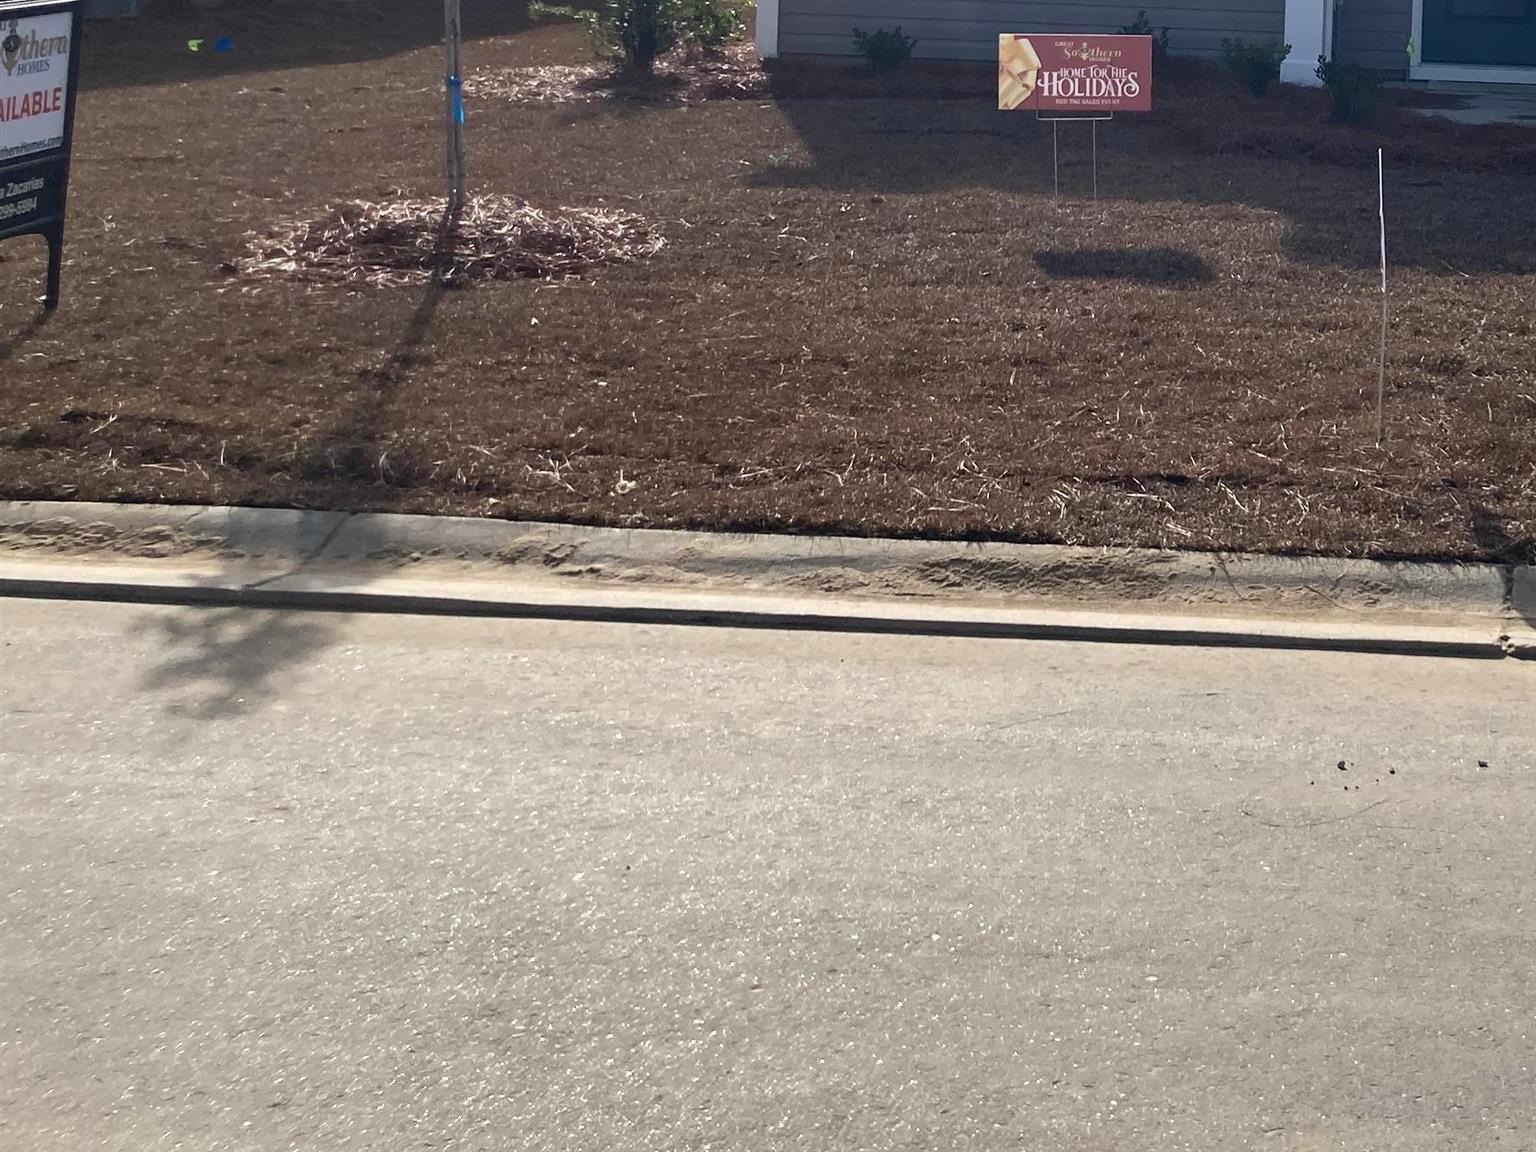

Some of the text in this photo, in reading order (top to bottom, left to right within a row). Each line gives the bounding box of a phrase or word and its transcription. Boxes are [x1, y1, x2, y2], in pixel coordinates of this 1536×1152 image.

[17, 59, 50, 76] HOMES
[1060, 67, 1087, 78] HOME
[1037, 71, 1140, 98] HOLIDAYS
